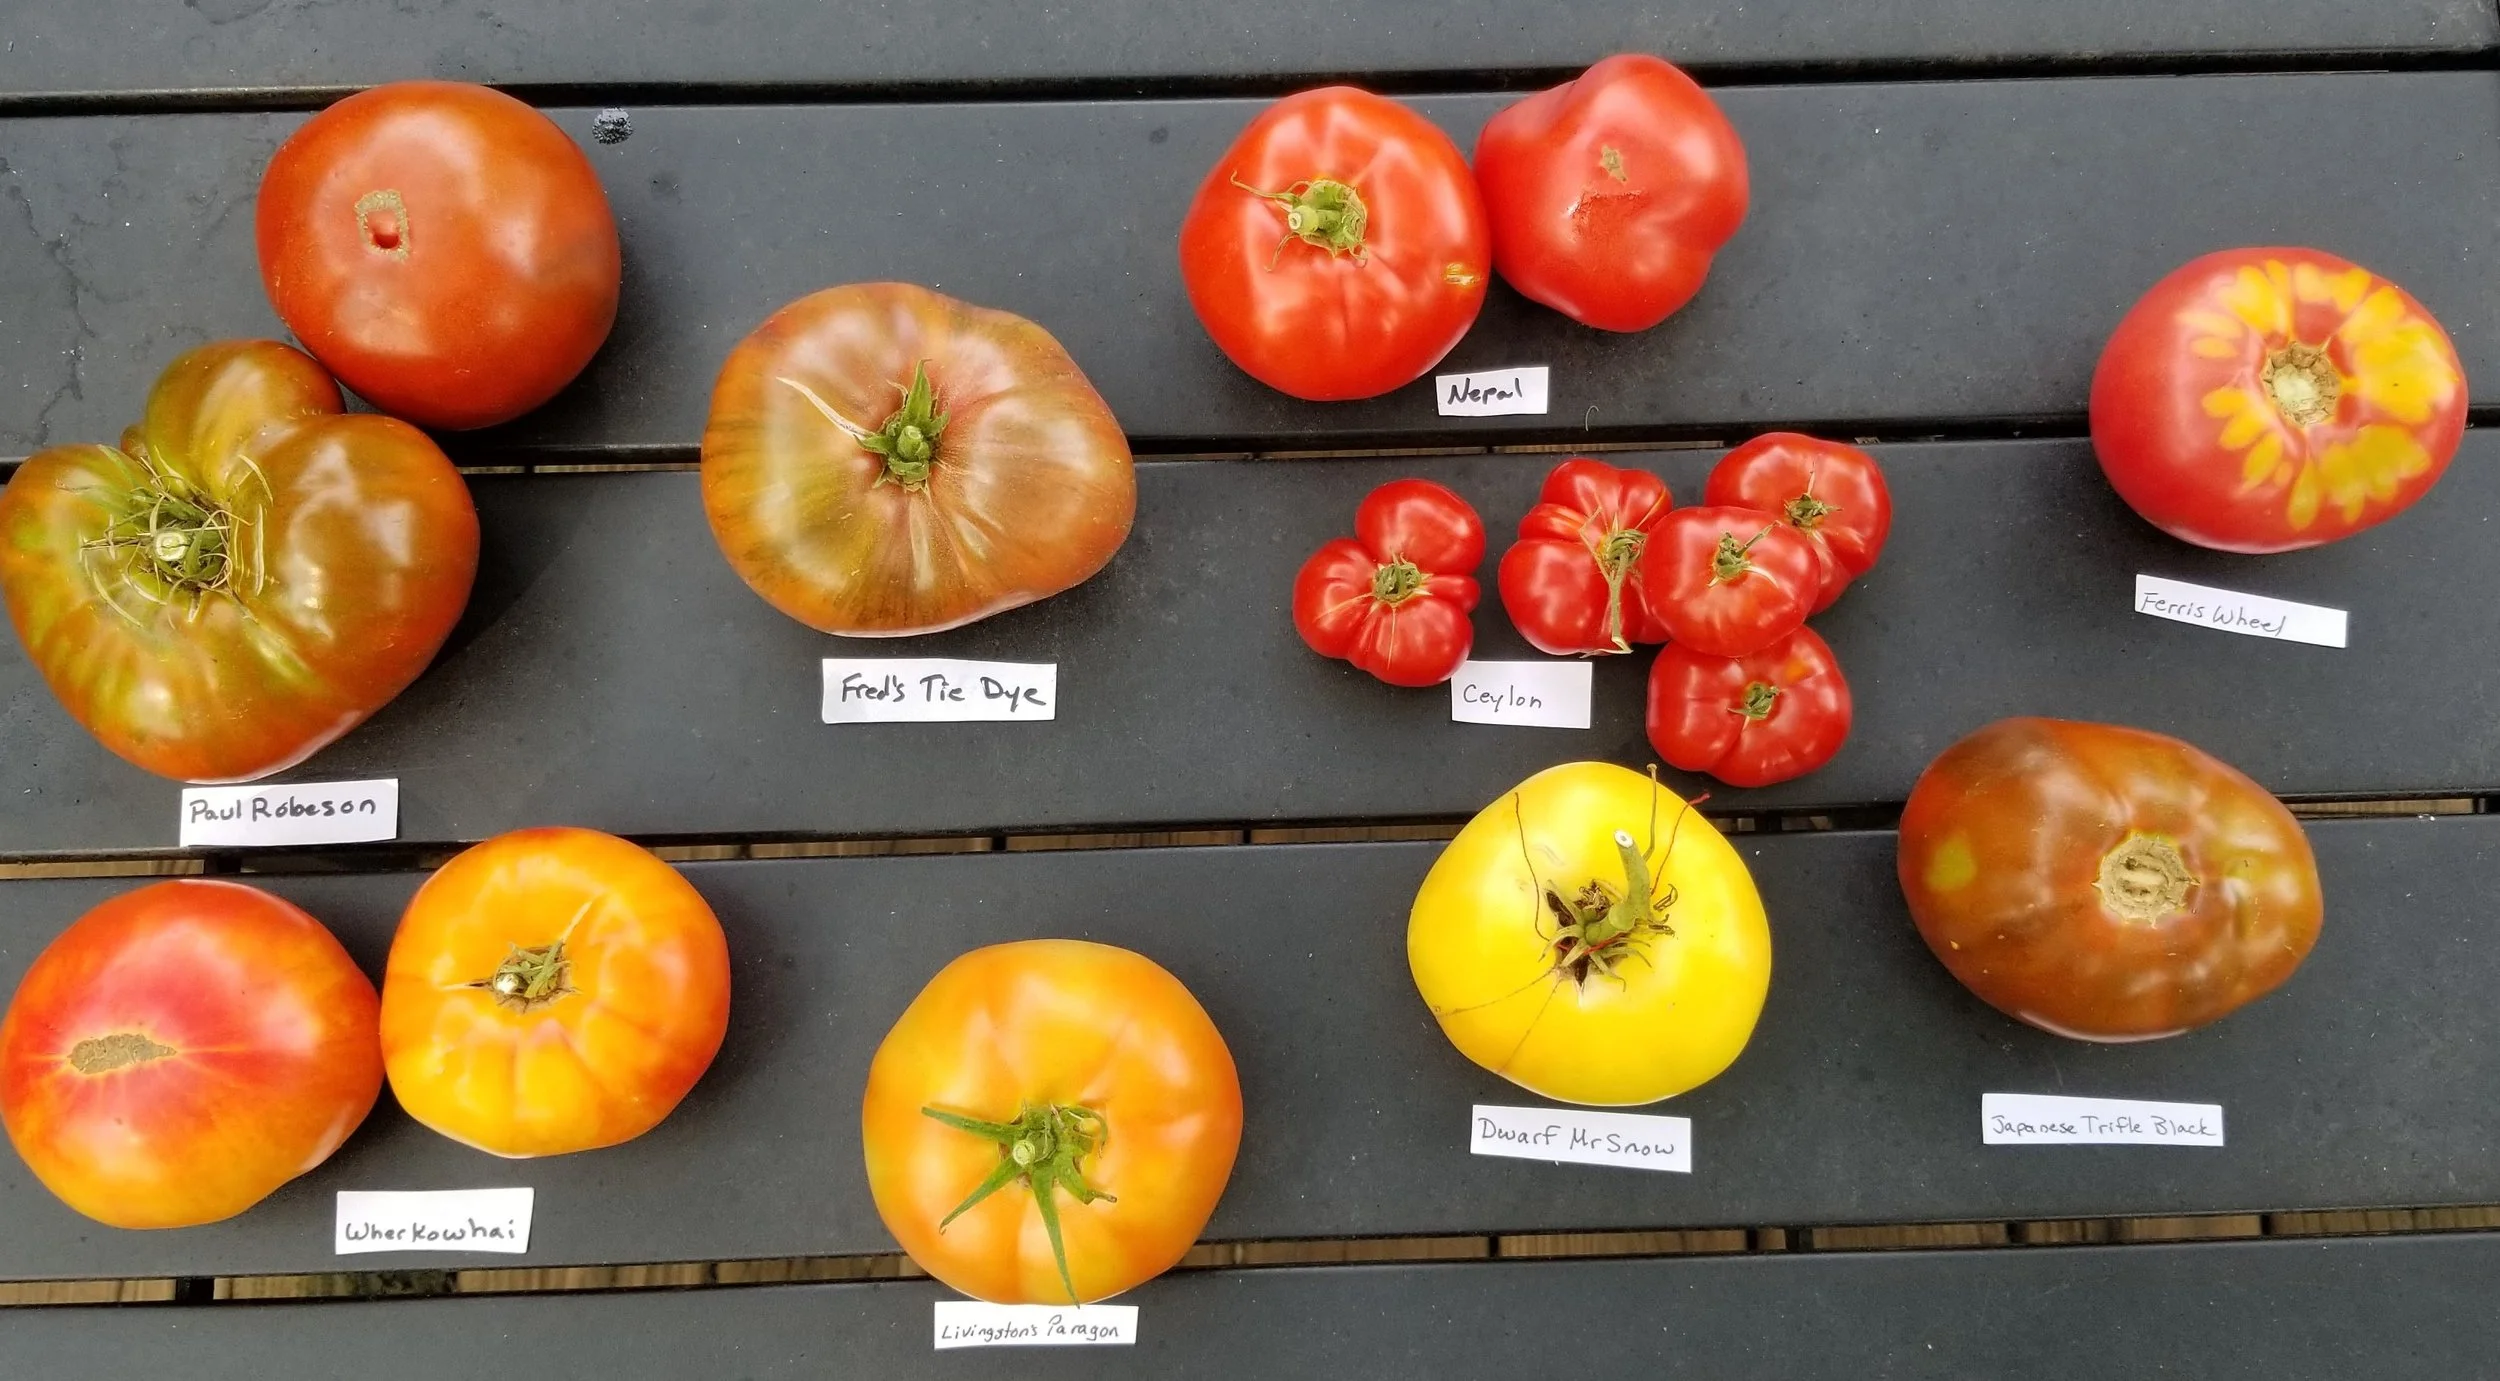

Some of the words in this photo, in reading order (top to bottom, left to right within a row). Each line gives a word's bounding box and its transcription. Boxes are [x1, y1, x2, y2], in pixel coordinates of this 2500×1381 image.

[1446, 376, 1524, 407] Nepal
[2142, 592, 2206, 619] Ferris
[2212, 605, 2287, 635] Wheel
[841, 672, 907, 703] Fred's
[919, 673, 967, 703] Tie
[979, 676, 1048, 713] Dye
[1463, 683, 1543, 713] Ceylon
[189, 799, 243, 824] Paul
[251, 795, 377, 823] Robeson
[1477, 1117, 1563, 1146] Dwarf
[1569, 1127, 1602, 1150] Mr
[1606, 1133, 1676, 1157] Snow
[1991, 1114, 2078, 1137] Japanese
[2080, 1115, 2143, 1135] Trifle
[2150, 1115, 2218, 1136] Black
[941, 1321, 1041, 1343] Livingston's
[1044, 1314, 1120, 1342] Paragon
